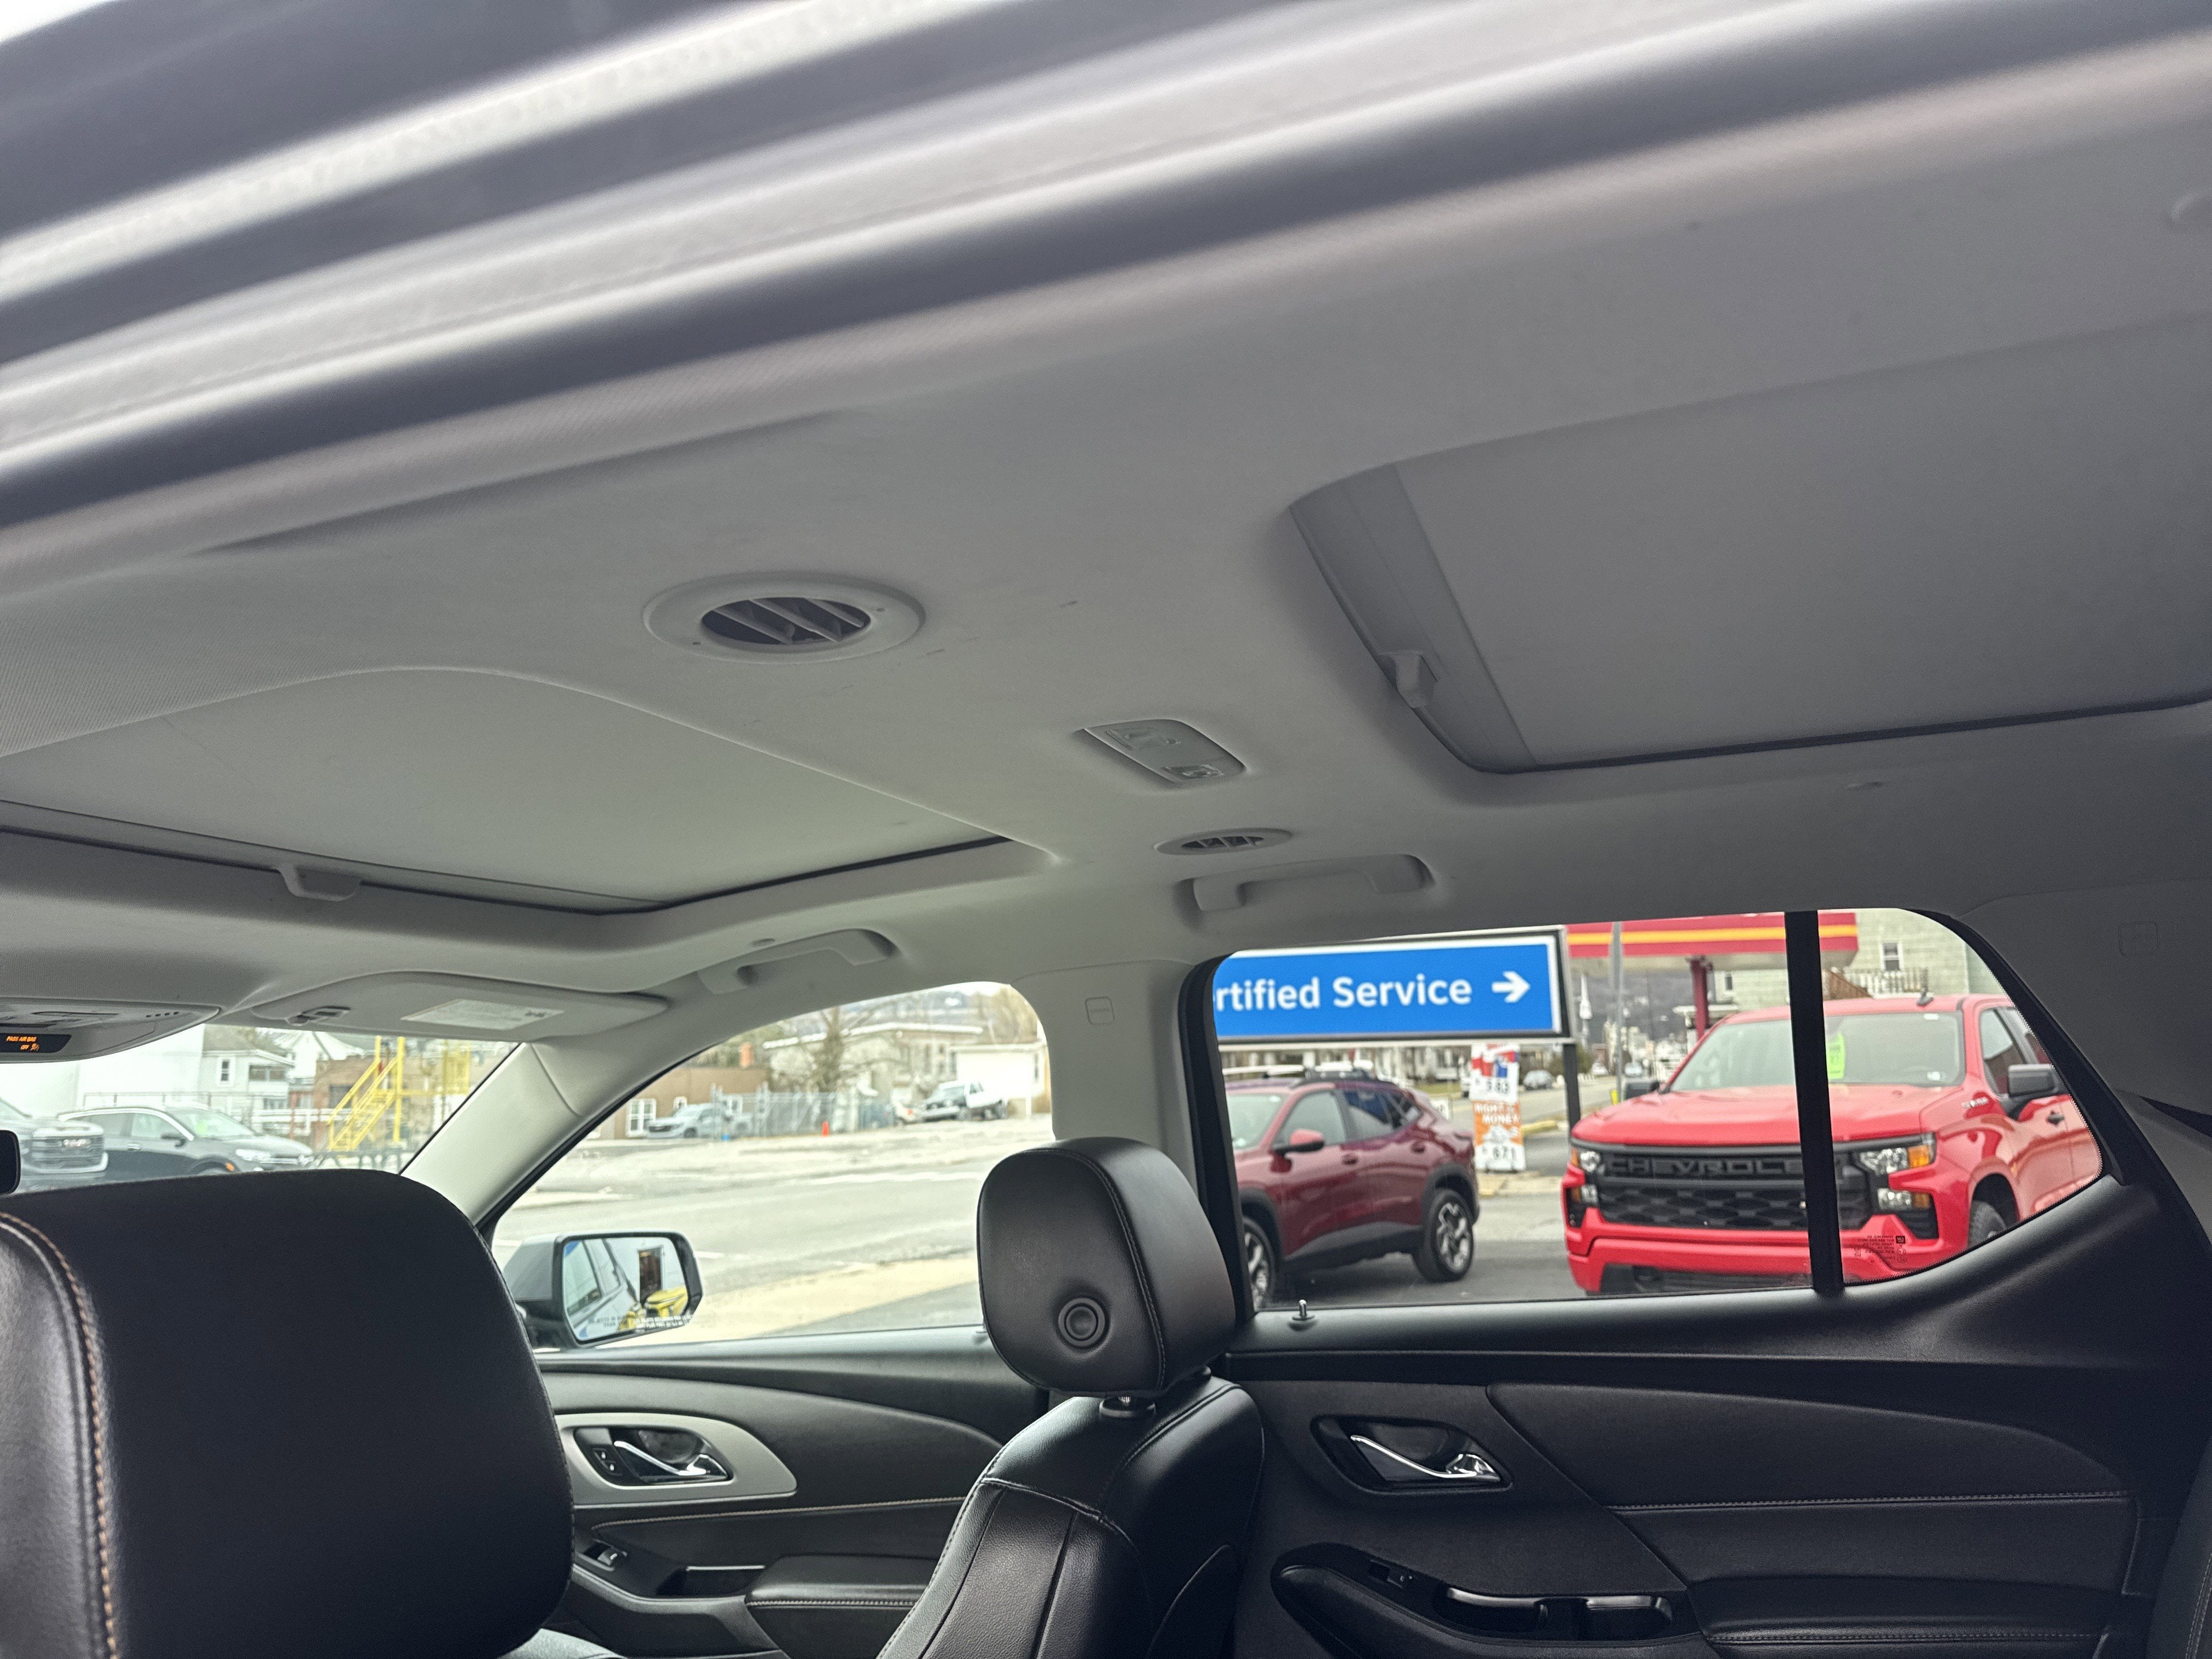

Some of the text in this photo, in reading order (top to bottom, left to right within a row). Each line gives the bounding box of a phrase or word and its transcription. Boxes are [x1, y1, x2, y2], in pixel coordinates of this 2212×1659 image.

[1215, 972, 1472, 1012] rtified Service
[1607, 1156, 1803, 1176] CHEVROLE
